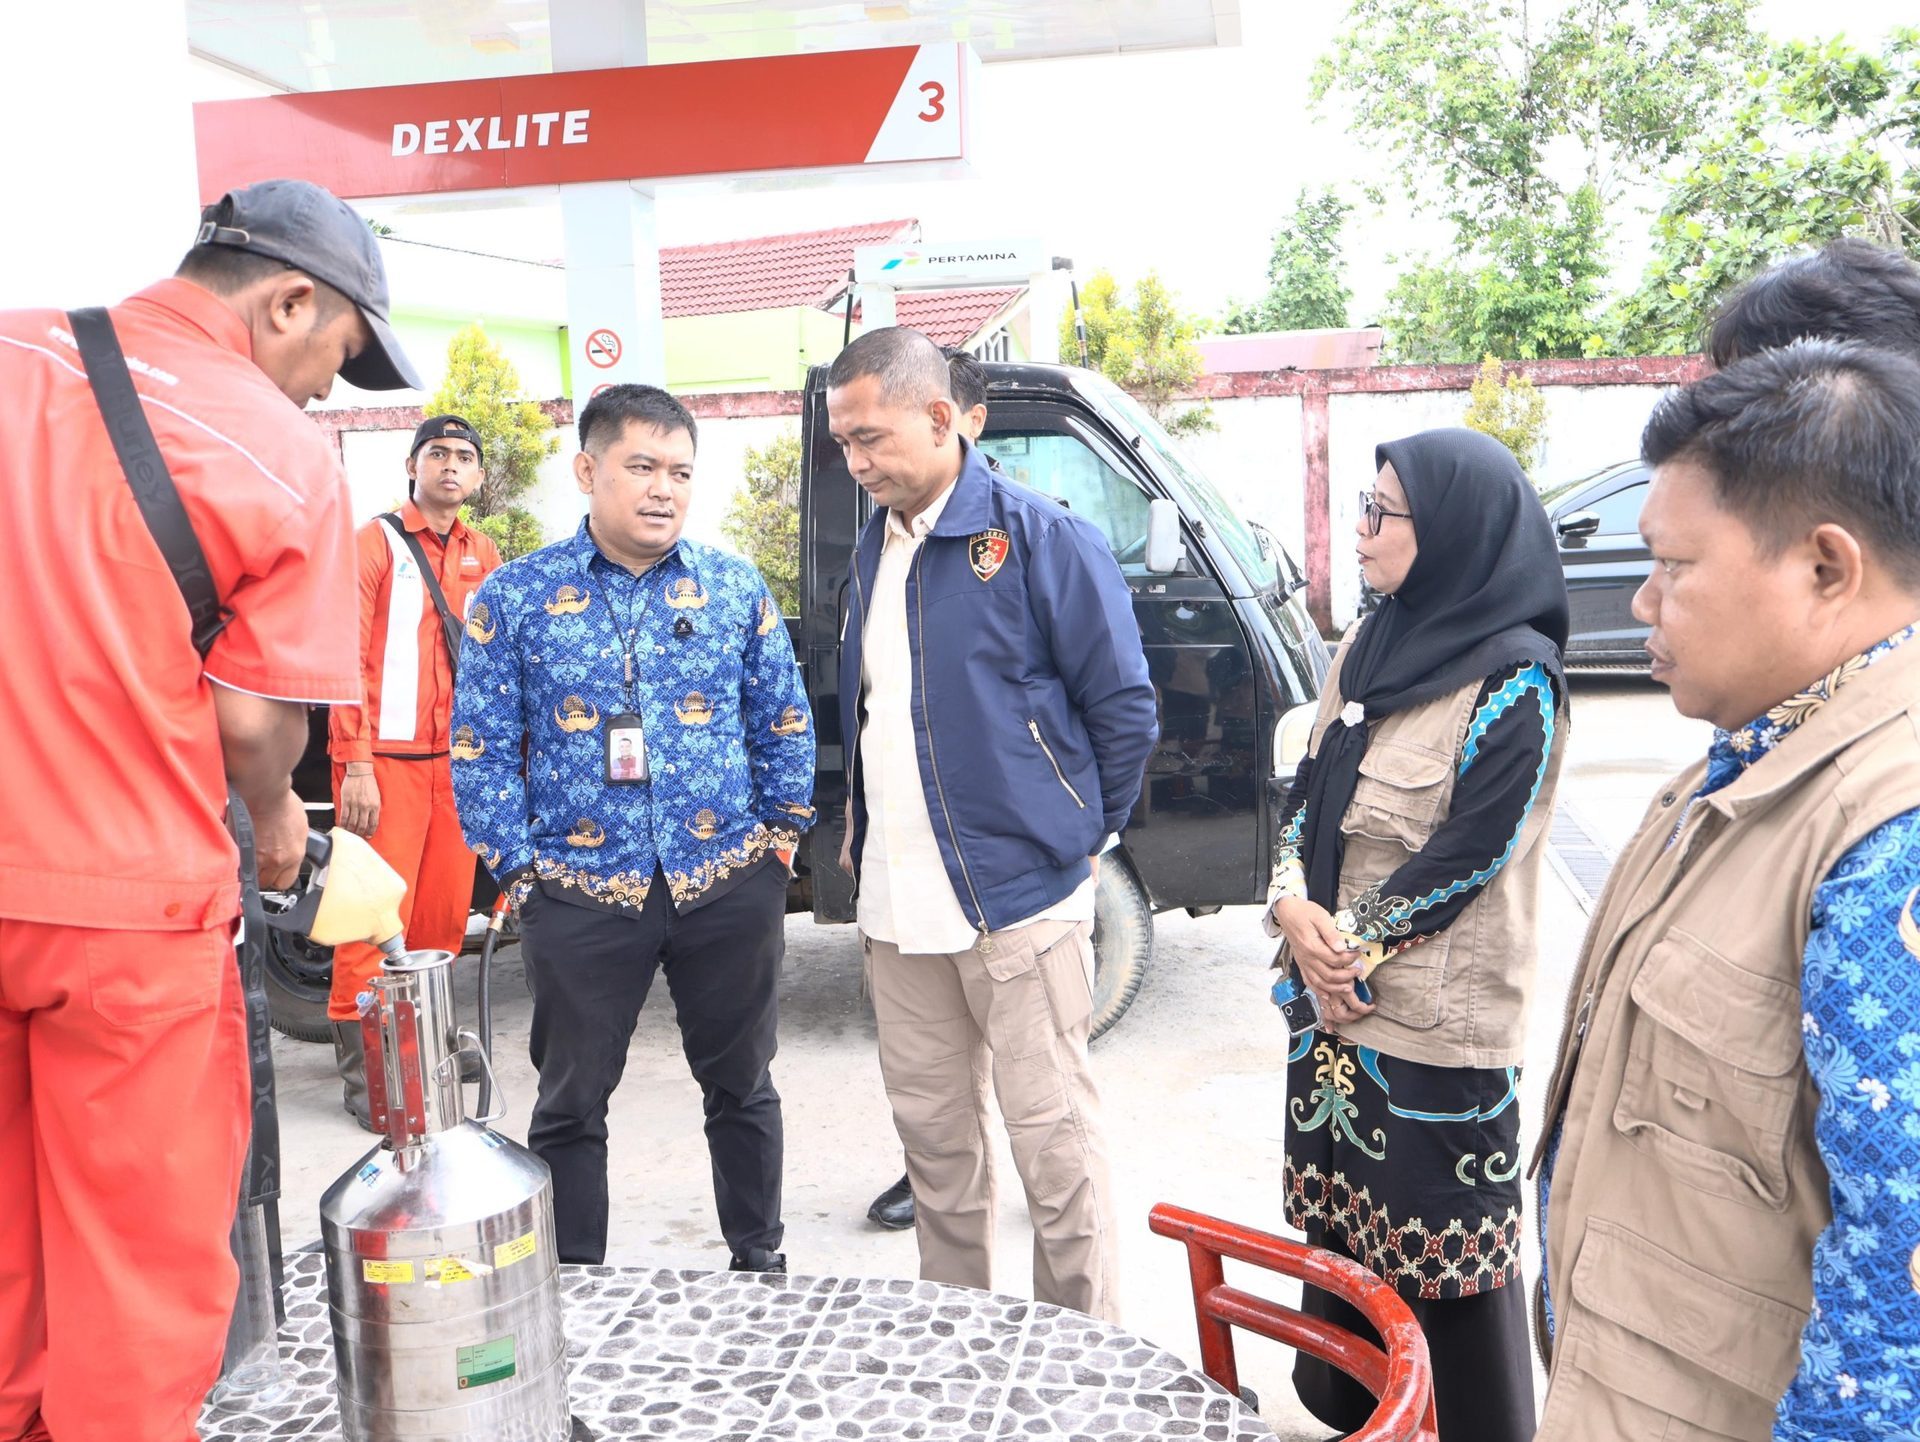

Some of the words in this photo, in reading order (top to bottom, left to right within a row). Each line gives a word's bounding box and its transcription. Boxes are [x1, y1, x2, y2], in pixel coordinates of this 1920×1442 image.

[917, 80, 945, 123] 3
[391, 109, 591, 157] DEXLITE
[928, 252, 1017, 264] PERTAMINA
